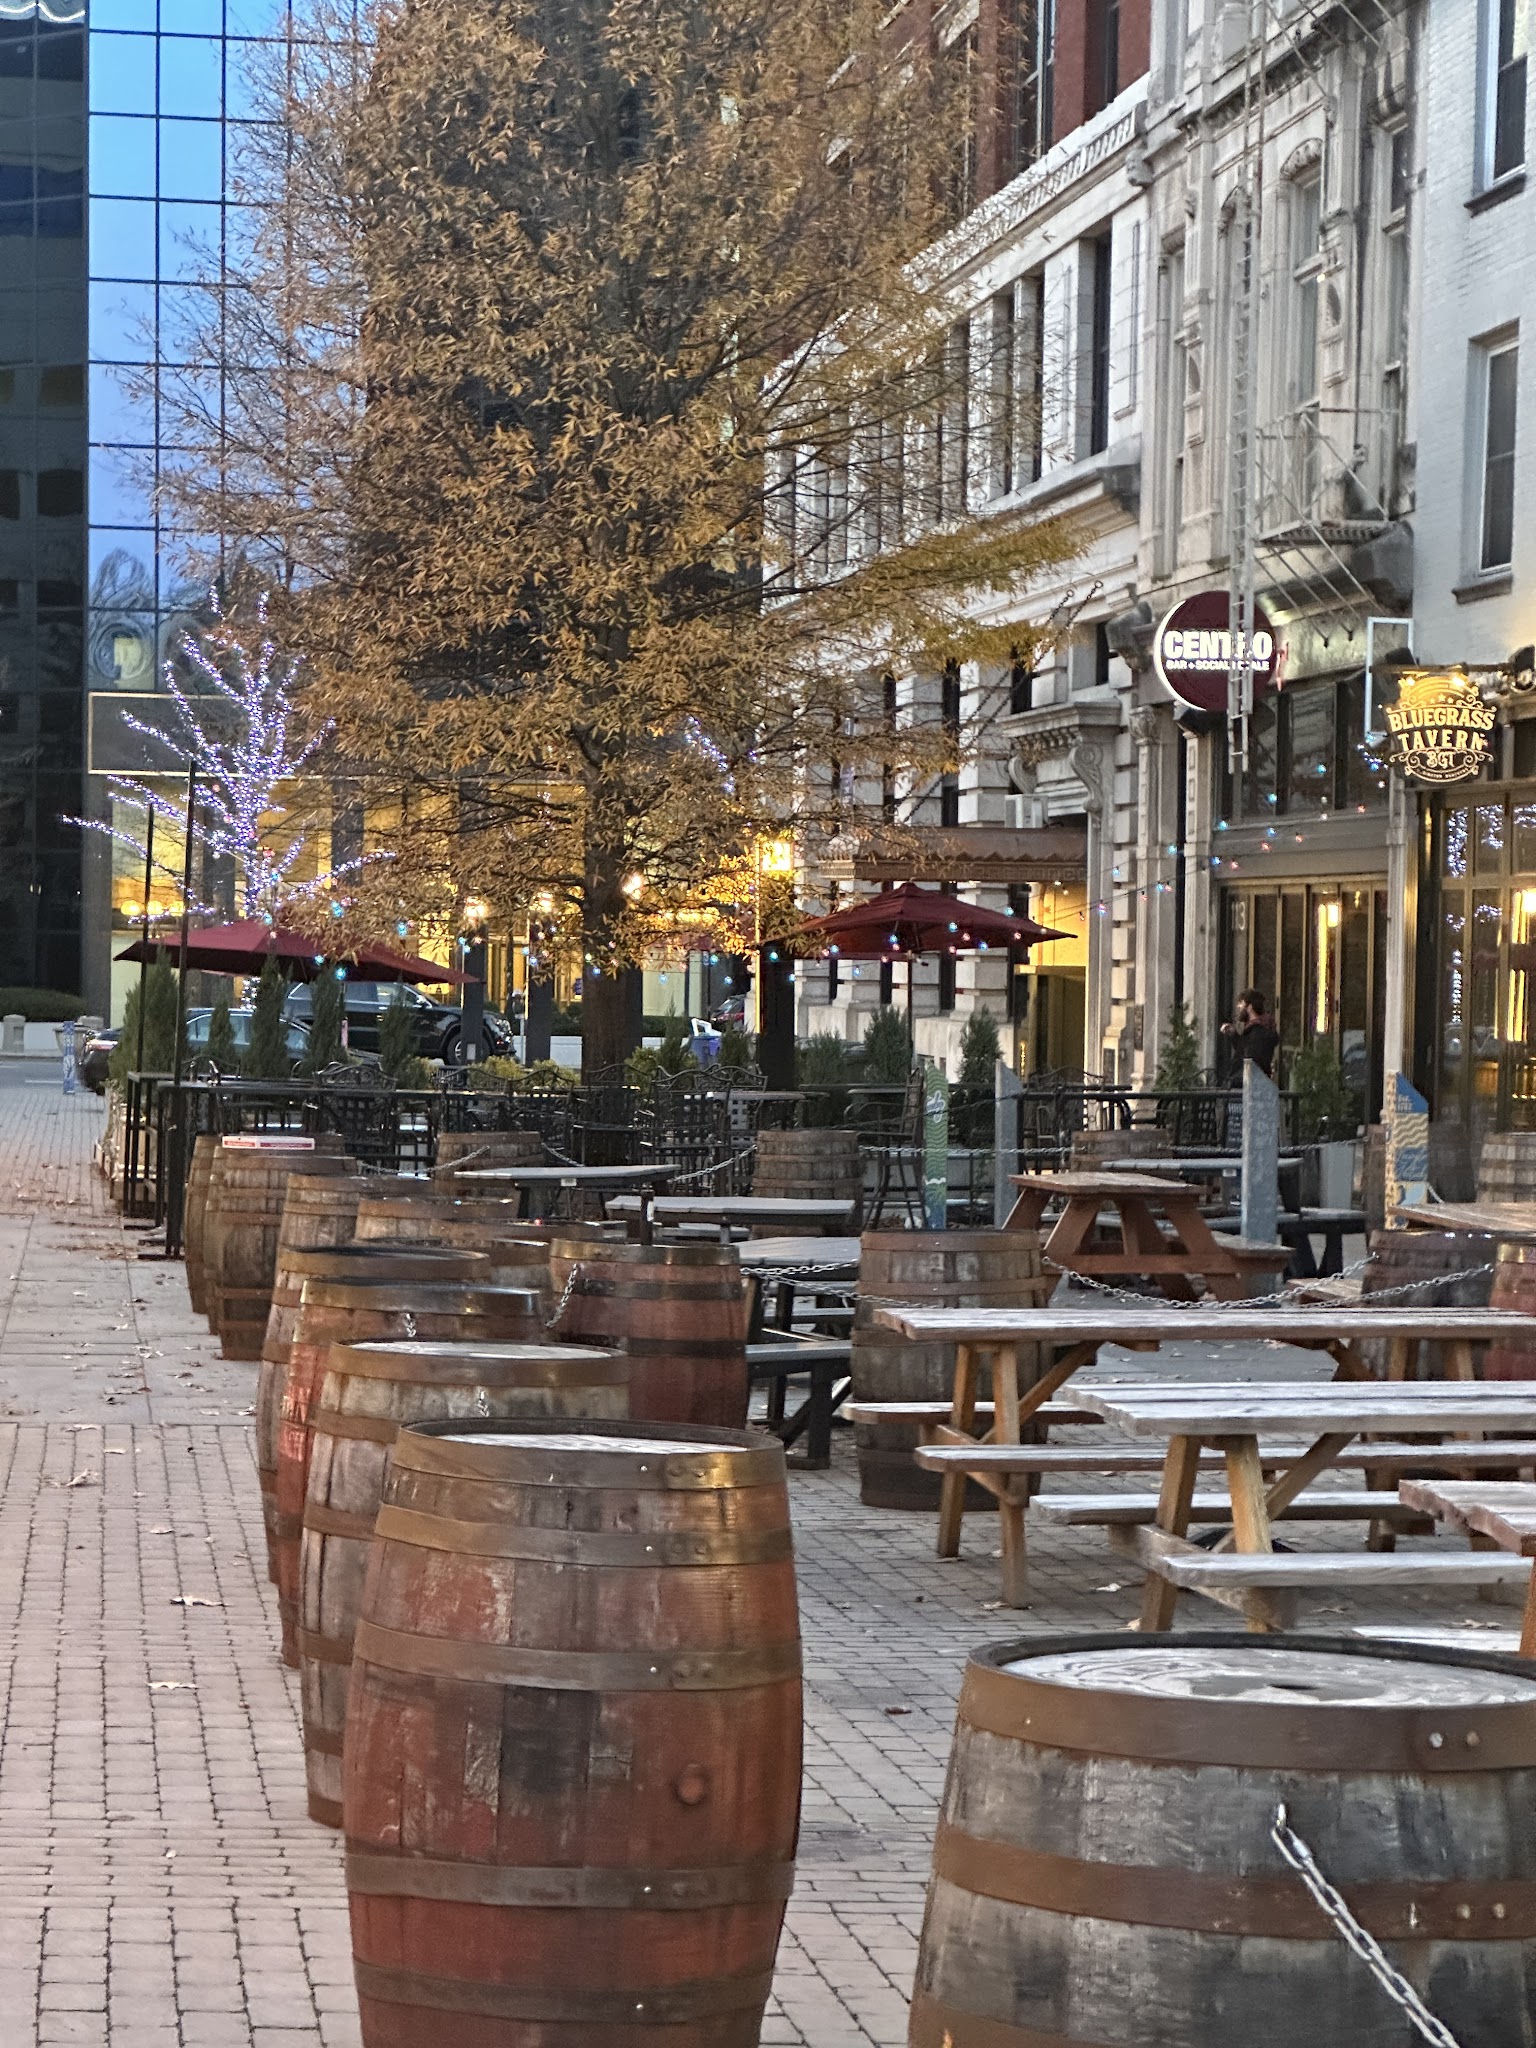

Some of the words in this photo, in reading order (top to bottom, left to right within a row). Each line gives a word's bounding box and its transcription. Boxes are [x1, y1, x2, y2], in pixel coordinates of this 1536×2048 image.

[1164, 630, 1273, 660] CENTRO
[1166, 660, 1187, 670] BAR
[1196, 660, 1230, 670] SOCIAL
[1388, 707, 1496, 732] BLUEGRASS
[1398, 729, 1486, 751] TAVERN
